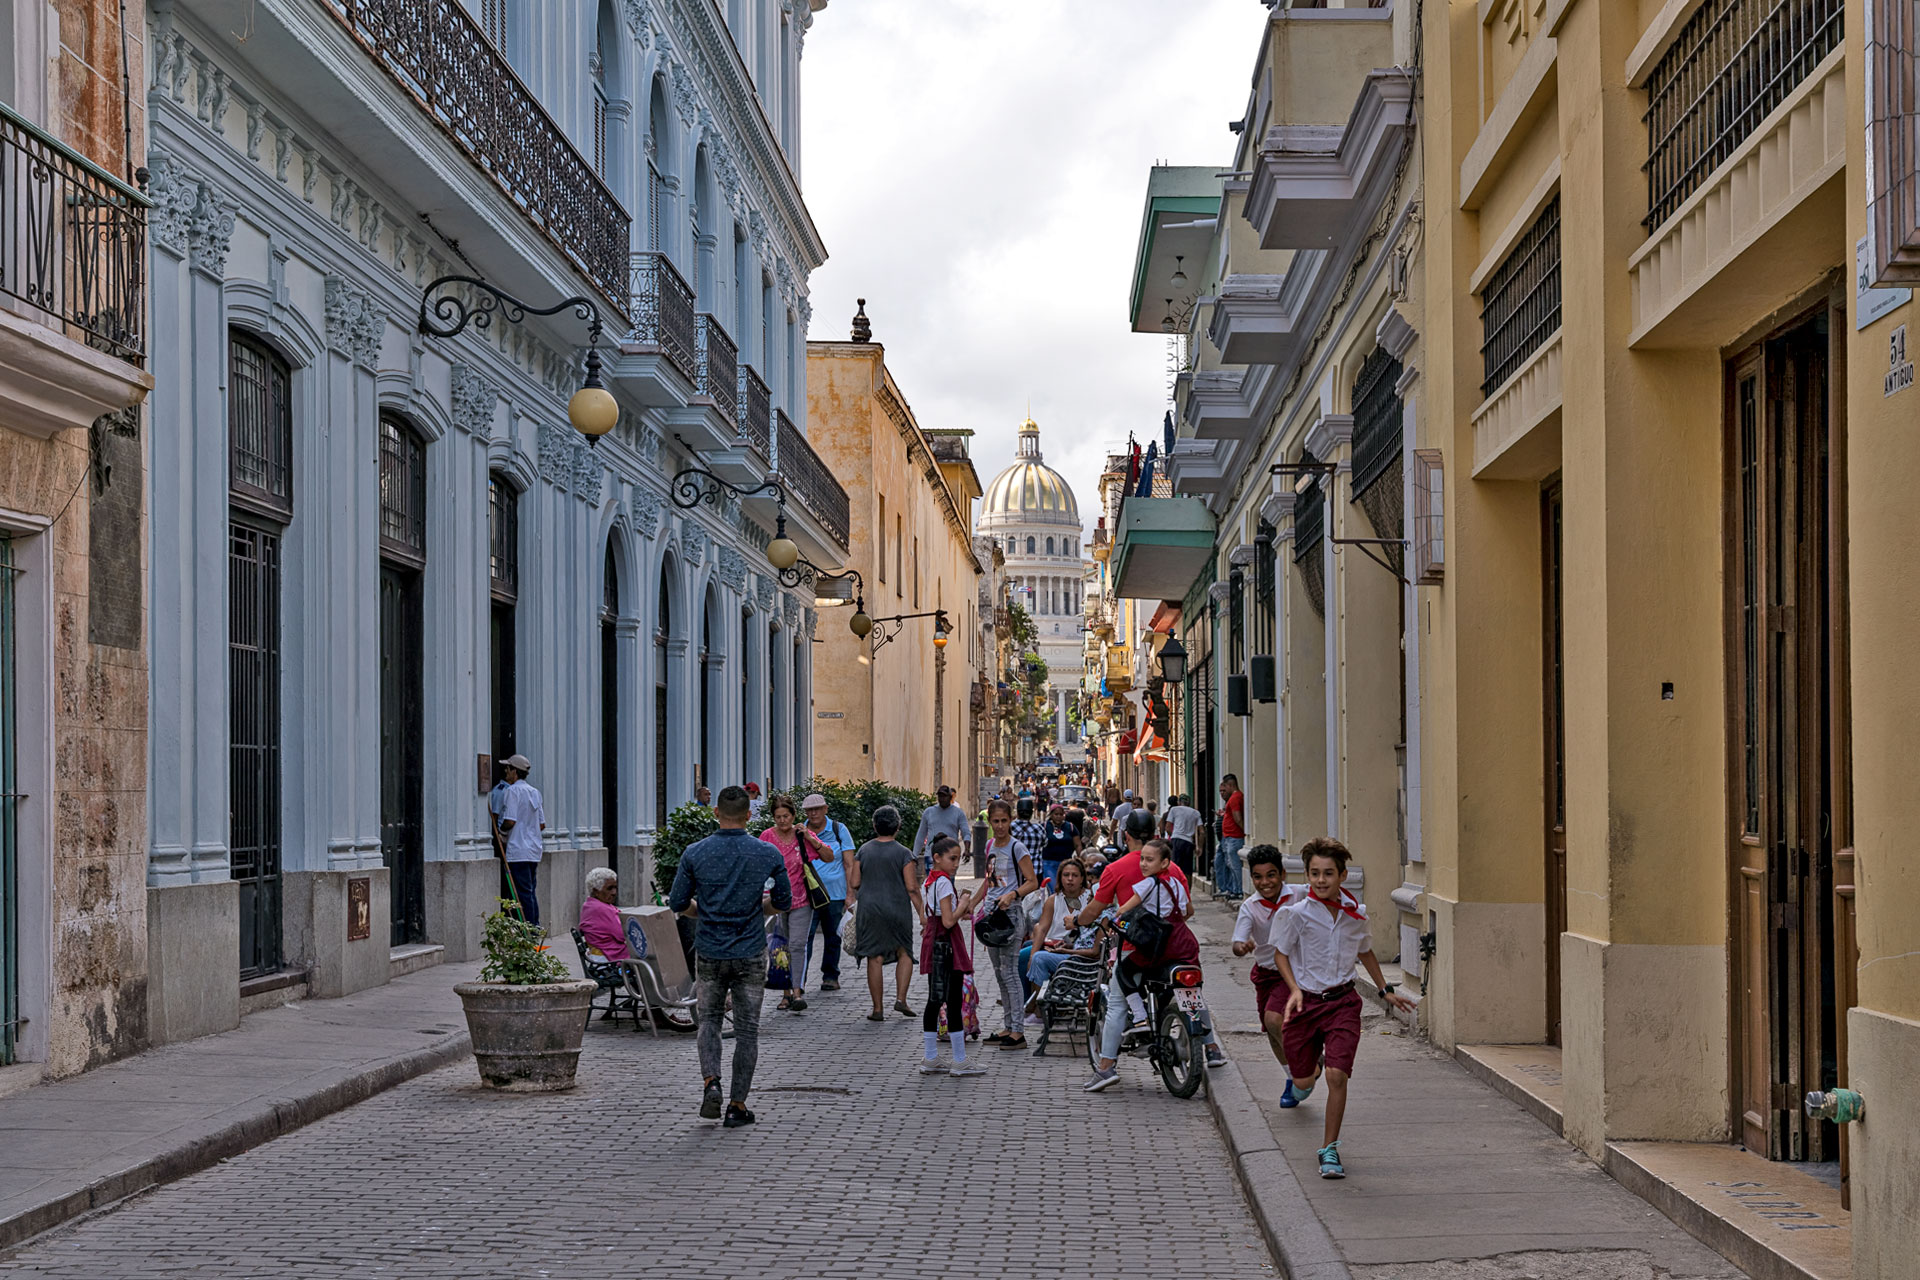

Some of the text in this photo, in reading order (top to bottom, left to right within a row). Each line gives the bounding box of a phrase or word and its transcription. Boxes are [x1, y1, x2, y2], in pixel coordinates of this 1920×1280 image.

[1890, 329, 1905, 364] 54
[1884, 364, 1914, 393] ANTIGUO
[1185, 990, 1192, 998] P
